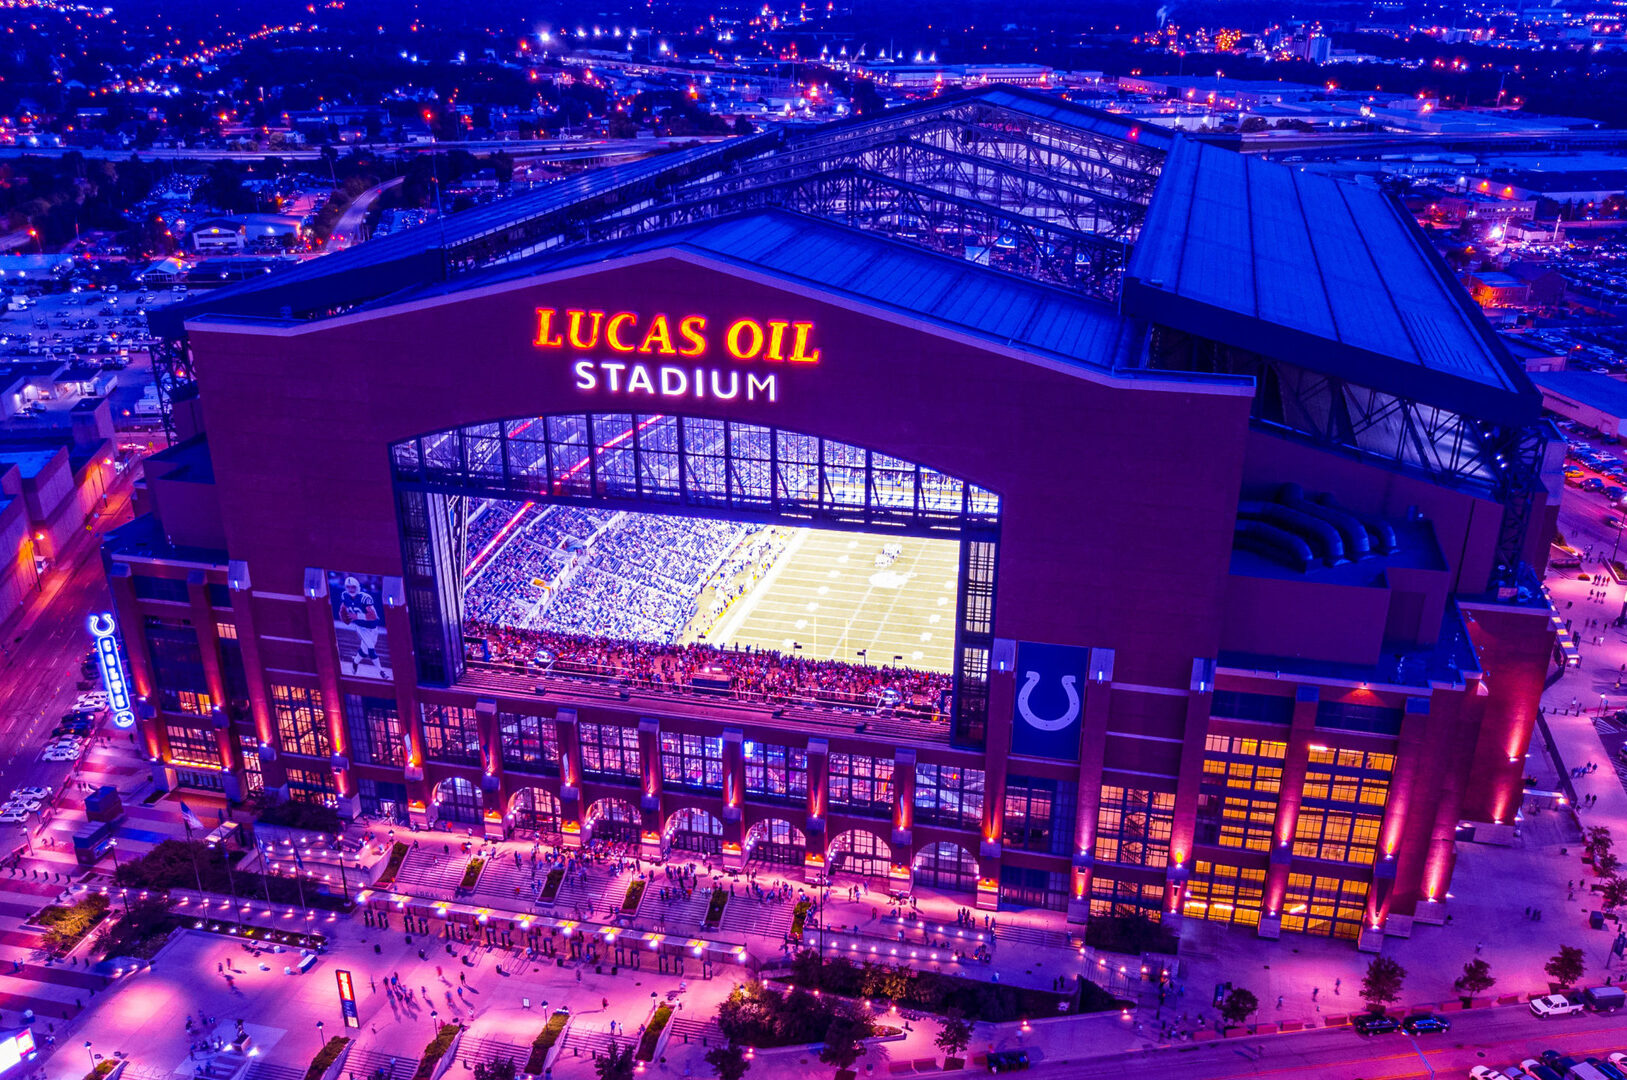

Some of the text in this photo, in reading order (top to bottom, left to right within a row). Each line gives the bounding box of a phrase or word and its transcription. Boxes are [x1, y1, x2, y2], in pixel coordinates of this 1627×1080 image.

[532, 307, 821, 364] LUCAS OIL
[574, 360, 777, 402] STADIUM
[102, 639, 125, 708] COLTS
